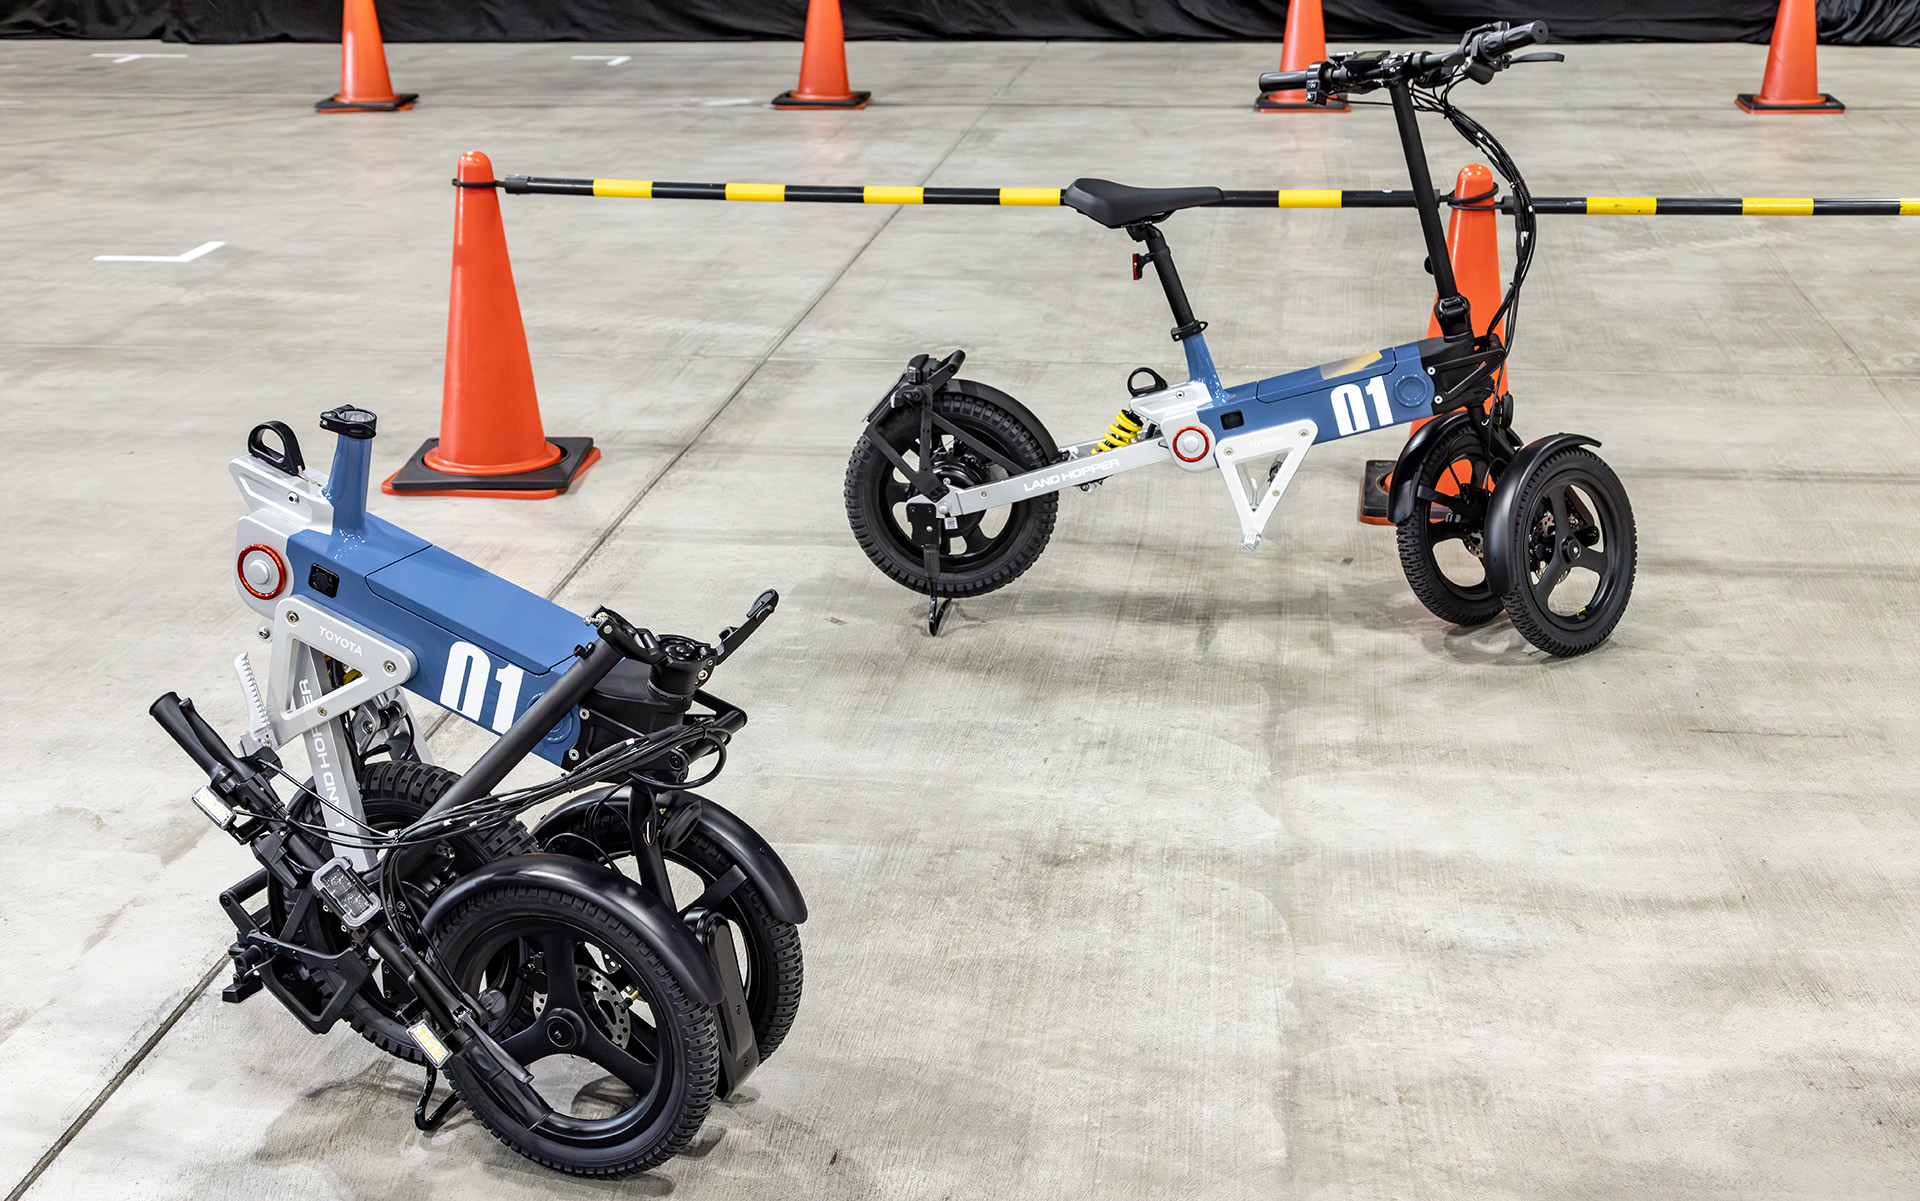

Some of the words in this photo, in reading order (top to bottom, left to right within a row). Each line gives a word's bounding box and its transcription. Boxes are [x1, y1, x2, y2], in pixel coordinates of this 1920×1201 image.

[1331, 375, 1394, 436] 01
[1248, 435, 1283, 449] TOYOTA
[1023, 474, 1060, 492] LAND
[1061, 458, 1121, 481] HOPPER
[319, 625, 363, 657] TOYOTA
[440, 641, 524, 735] 01
[299, 678, 331, 769] HOPER
